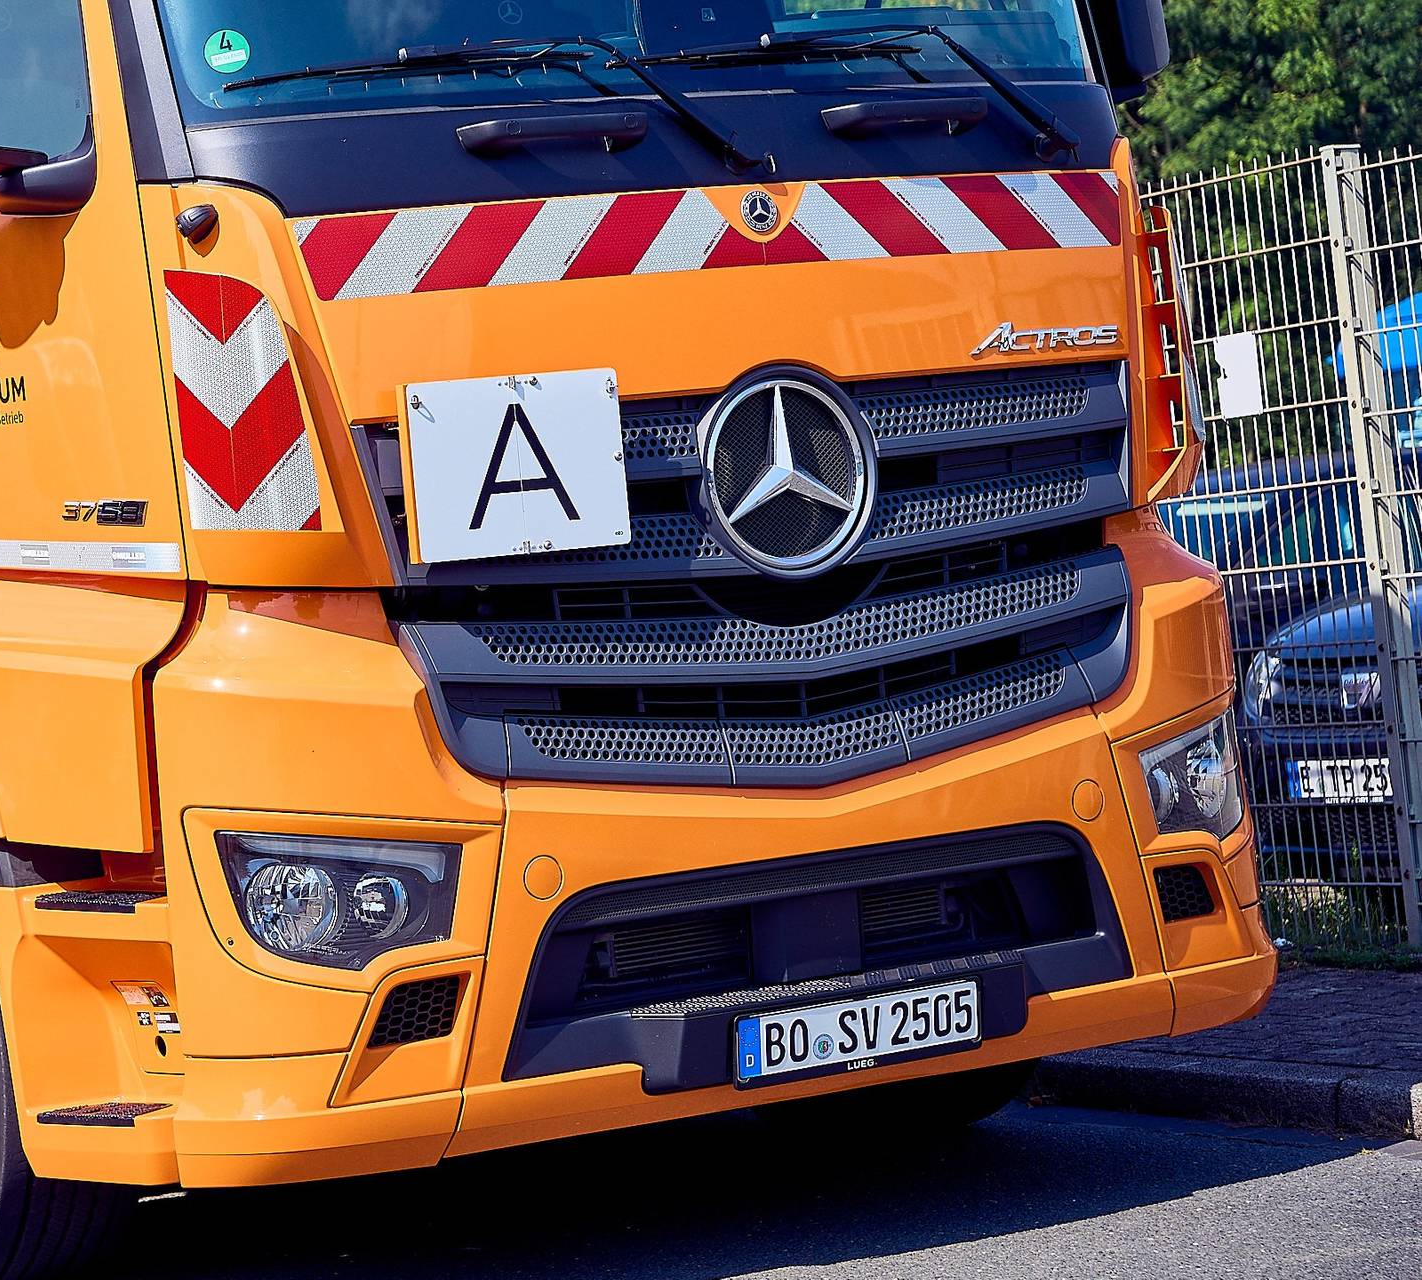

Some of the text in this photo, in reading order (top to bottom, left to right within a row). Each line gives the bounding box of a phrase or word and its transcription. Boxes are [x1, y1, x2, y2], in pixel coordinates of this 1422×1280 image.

[220, 31, 233, 50] 4
[969, 321, 1118, 356] ACTROS
[469, 403, 581, 530] A
[765, 989, 972, 1067] BO SV 2505
[746, 1054, 755, 1068] D
